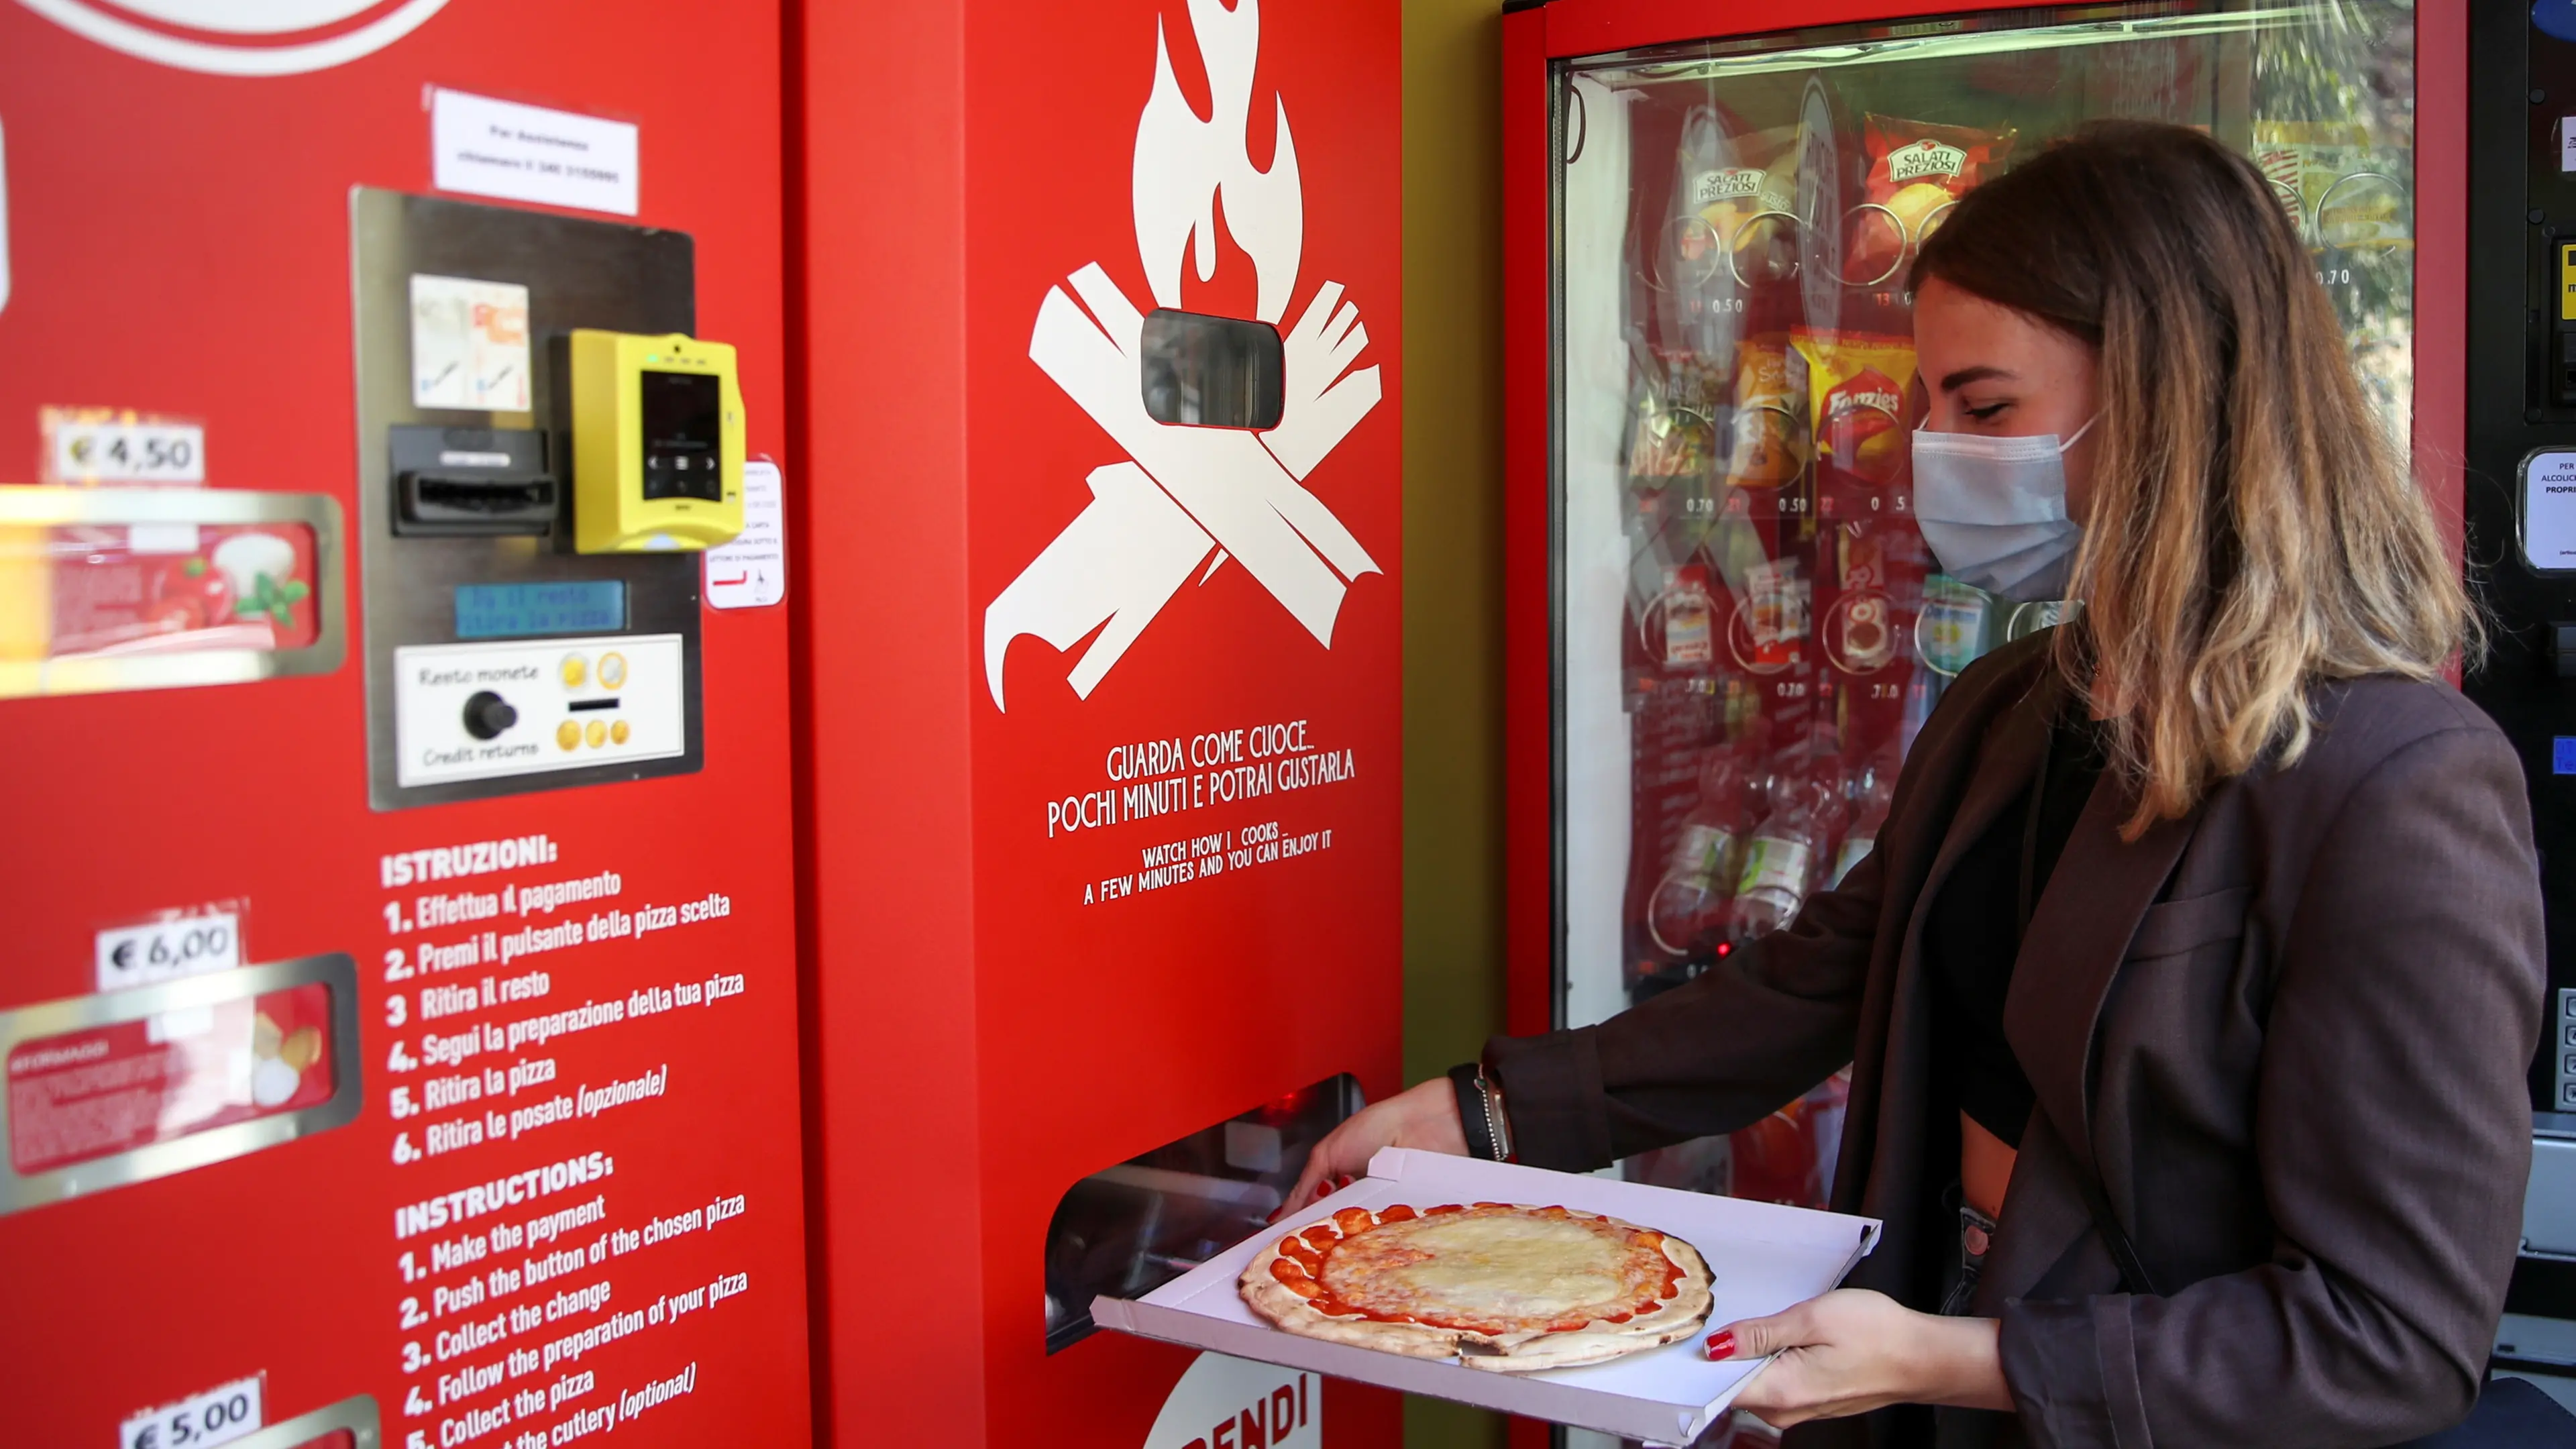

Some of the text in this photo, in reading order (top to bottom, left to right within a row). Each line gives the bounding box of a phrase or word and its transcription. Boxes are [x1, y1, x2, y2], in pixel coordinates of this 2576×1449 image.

[1707, 174, 1751, 184] SALATI
[1896, 161, 1956, 179] PREZIOSI
[1904, 151, 1950, 165] SALATI
[1700, 182, 1756, 199] PREZIOSI
[108, 437, 192, 471] 4,50
[419, 665, 539, 687] Resto monete
[423, 742, 539, 767] Credit returns
[1107, 739, 1184, 782] GUARDA
[1191, 729, 1244, 767] COME
[1048, 749, 1355, 838] POCHI MINUTI E POTRAI GUSTARLA
[381, 835, 557, 888] ISTRUZIONI:
[1083, 830, 1332, 905] A FEW MINUTES AND YOU CAN ENJOY IT
[1142, 841, 1186, 869] WATCH
[1191, 833, 1222, 858] HOW
[1241, 822, 1279, 845] COOKS
[384, 870, 621, 934] 1. Effettua il pagamento
[110, 926, 228, 970] € 6,00
[384, 893, 731, 981] 2. Premi il pulsante della pizza scelta
[385, 970, 550, 1026] 3 Ritira il resto
[387, 973, 745, 1072] 4. Segui la preparazione della tua pizza
[389, 1058, 556, 1120] 5. Ritira la pizza
[392, 1063, 667, 1164] 6. Ritira le posate (opzionale)
[395, 1151, 614, 1239] INSTRUCTIONS:
[398, 1194, 606, 1282] 1. Make the payment
[399, 1193, 745, 1329] 2. Push the button of the chosen pizza
[402, 1280, 611, 1373] 3. Collect the change
[404, 1272, 748, 1417] 4. Follow the preparation of your pizza
[135, 1393, 249, 1449] € 5,00
[440, 1402, 511, 1449] Collect
[513, 1387, 546, 1419] the
[550, 1369, 595, 1408] pizza
[552, 1398, 616, 1445] cutlery
[620, 1362, 697, 1421] (optional)
